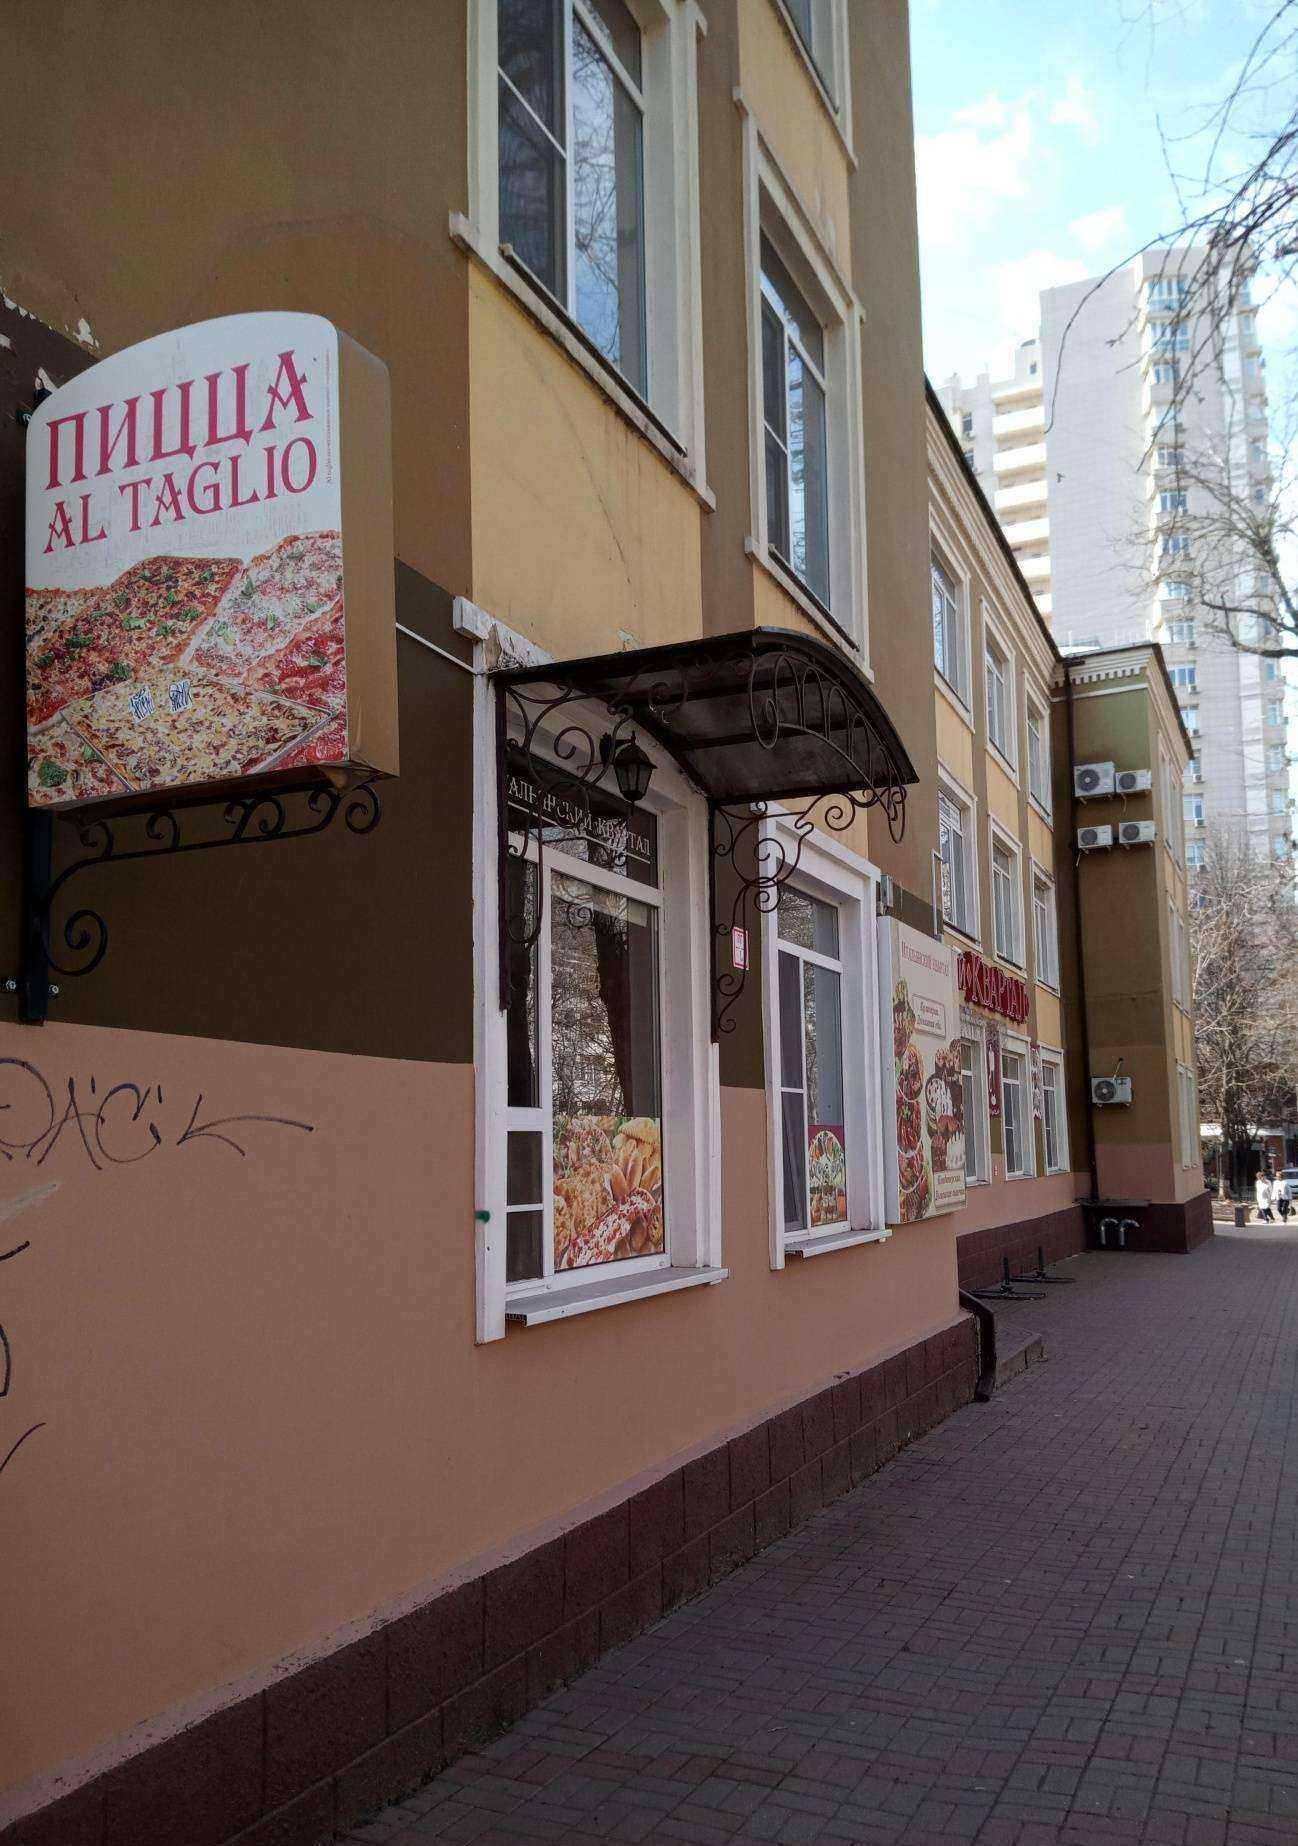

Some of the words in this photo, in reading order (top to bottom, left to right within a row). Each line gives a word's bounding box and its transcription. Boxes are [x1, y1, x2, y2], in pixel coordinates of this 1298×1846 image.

[45, 350, 314, 490] ПИЦЦА
[44, 494, 107, 554] AL
[118, 437, 317, 532] TAGLIO
